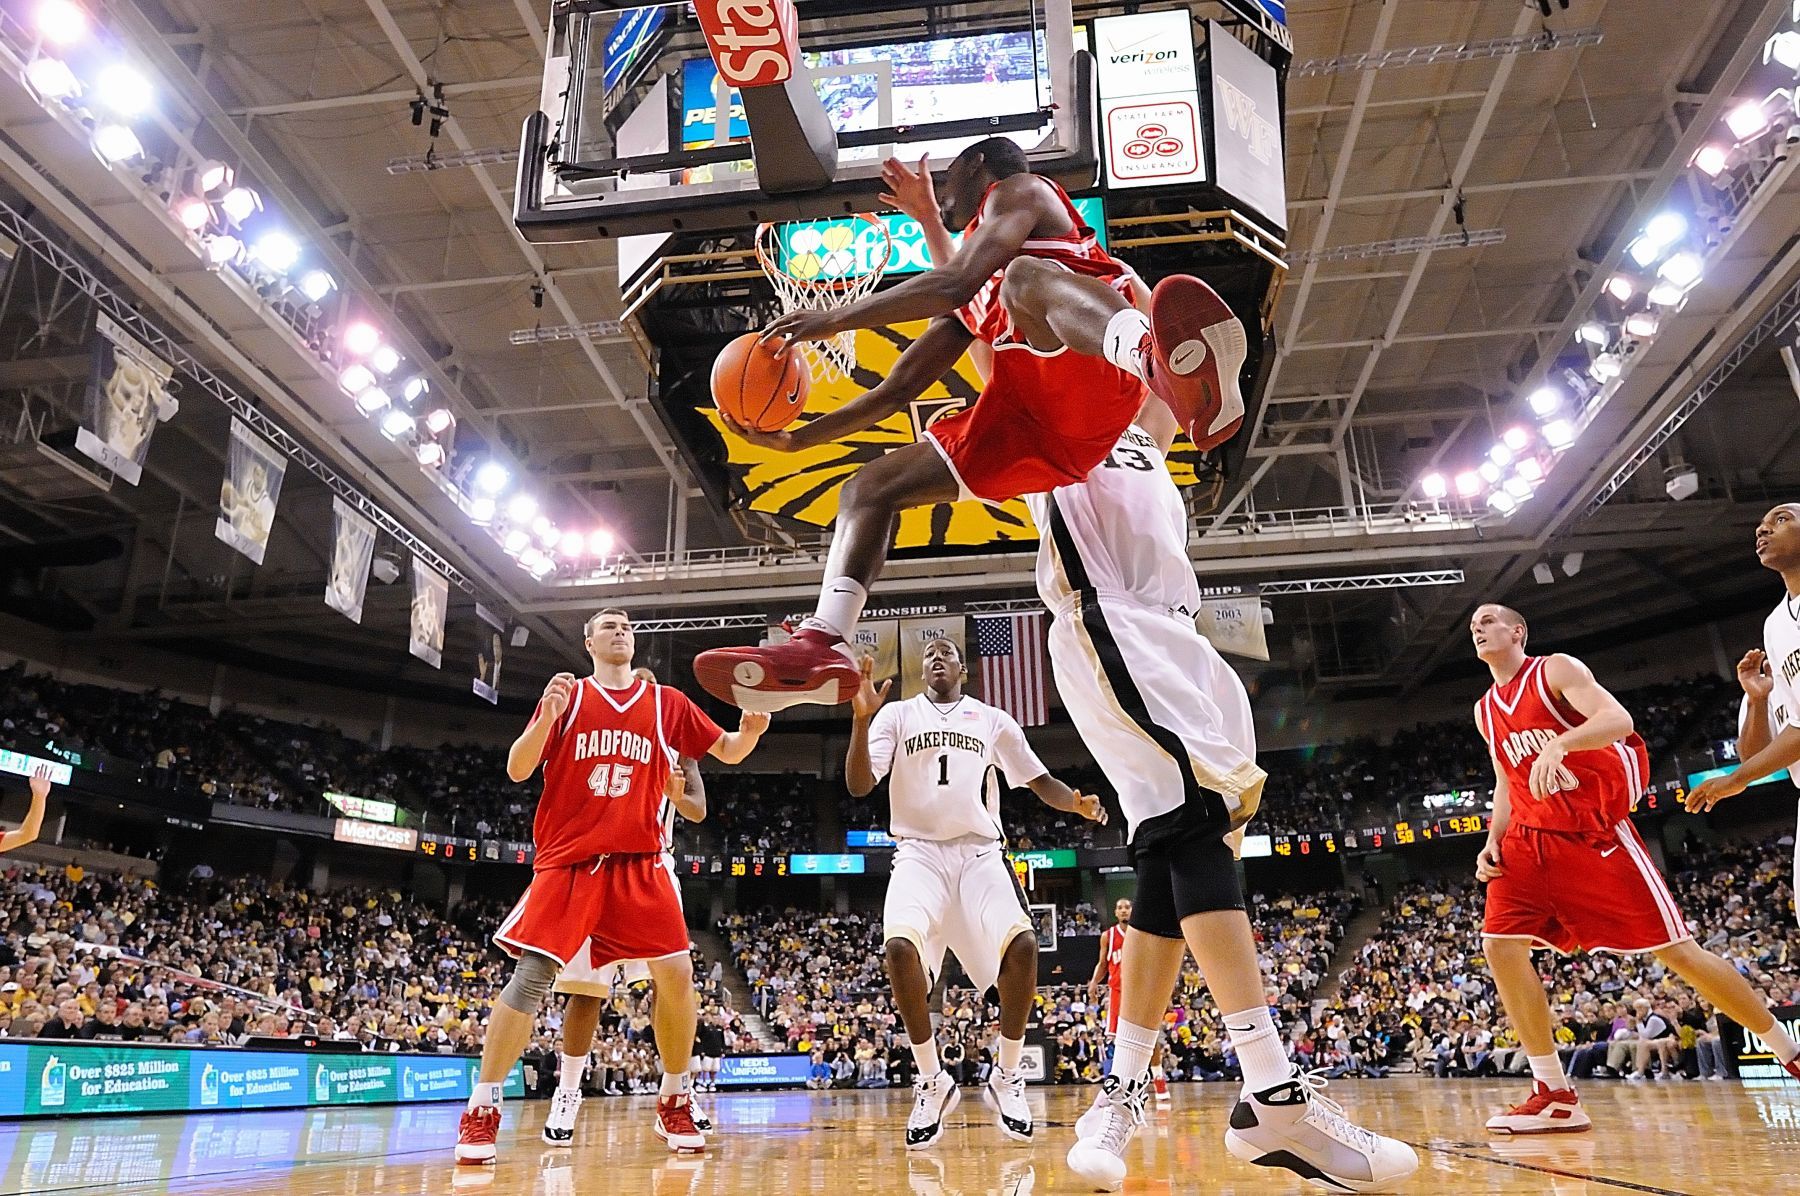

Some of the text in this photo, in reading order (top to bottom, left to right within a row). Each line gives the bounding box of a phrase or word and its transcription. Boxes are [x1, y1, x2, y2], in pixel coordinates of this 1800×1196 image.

[1110, 49, 1178, 65] verizon
[1117, 113, 1146, 121] STATE
[1120, 161, 1188, 172] INSURANCE
[1215, 608, 1242, 621] 2003
[855, 632, 877, 645] 1961
[922, 629, 945, 641] 1962
[575, 729, 652, 765] RADFORD
[905, 730, 985, 758] WAKE FOREST
[937, 754, 949, 785] 1
[587, 763, 634, 798] 45
[1449, 815, 1481, 833] 9:30
[342, 820, 411, 845] MedCost
[1373, 834, 1382, 848] 3
[421, 842, 437, 855] 42
[445, 844, 453, 857] 0
[1275, 843, 1291, 856] 42
[1301, 841, 1310, 855] 0
[516, 850, 525, 864] 3
[692, 862, 700, 874] 3
[731, 864, 745, 876] 30
[754, 864, 763, 876] 2
[778, 864, 786, 876] 2
[69, 1059, 179, 1081] Over $825 Million
[221, 1066, 299, 1084] Over $825 Million
[330, 1071, 348, 1082] Over
[81, 1082, 102, 1097] for
[104, 1076, 170, 1095] Education.
[229, 1080, 293, 1097] for Education.
[337, 1083, 349, 1093] for
